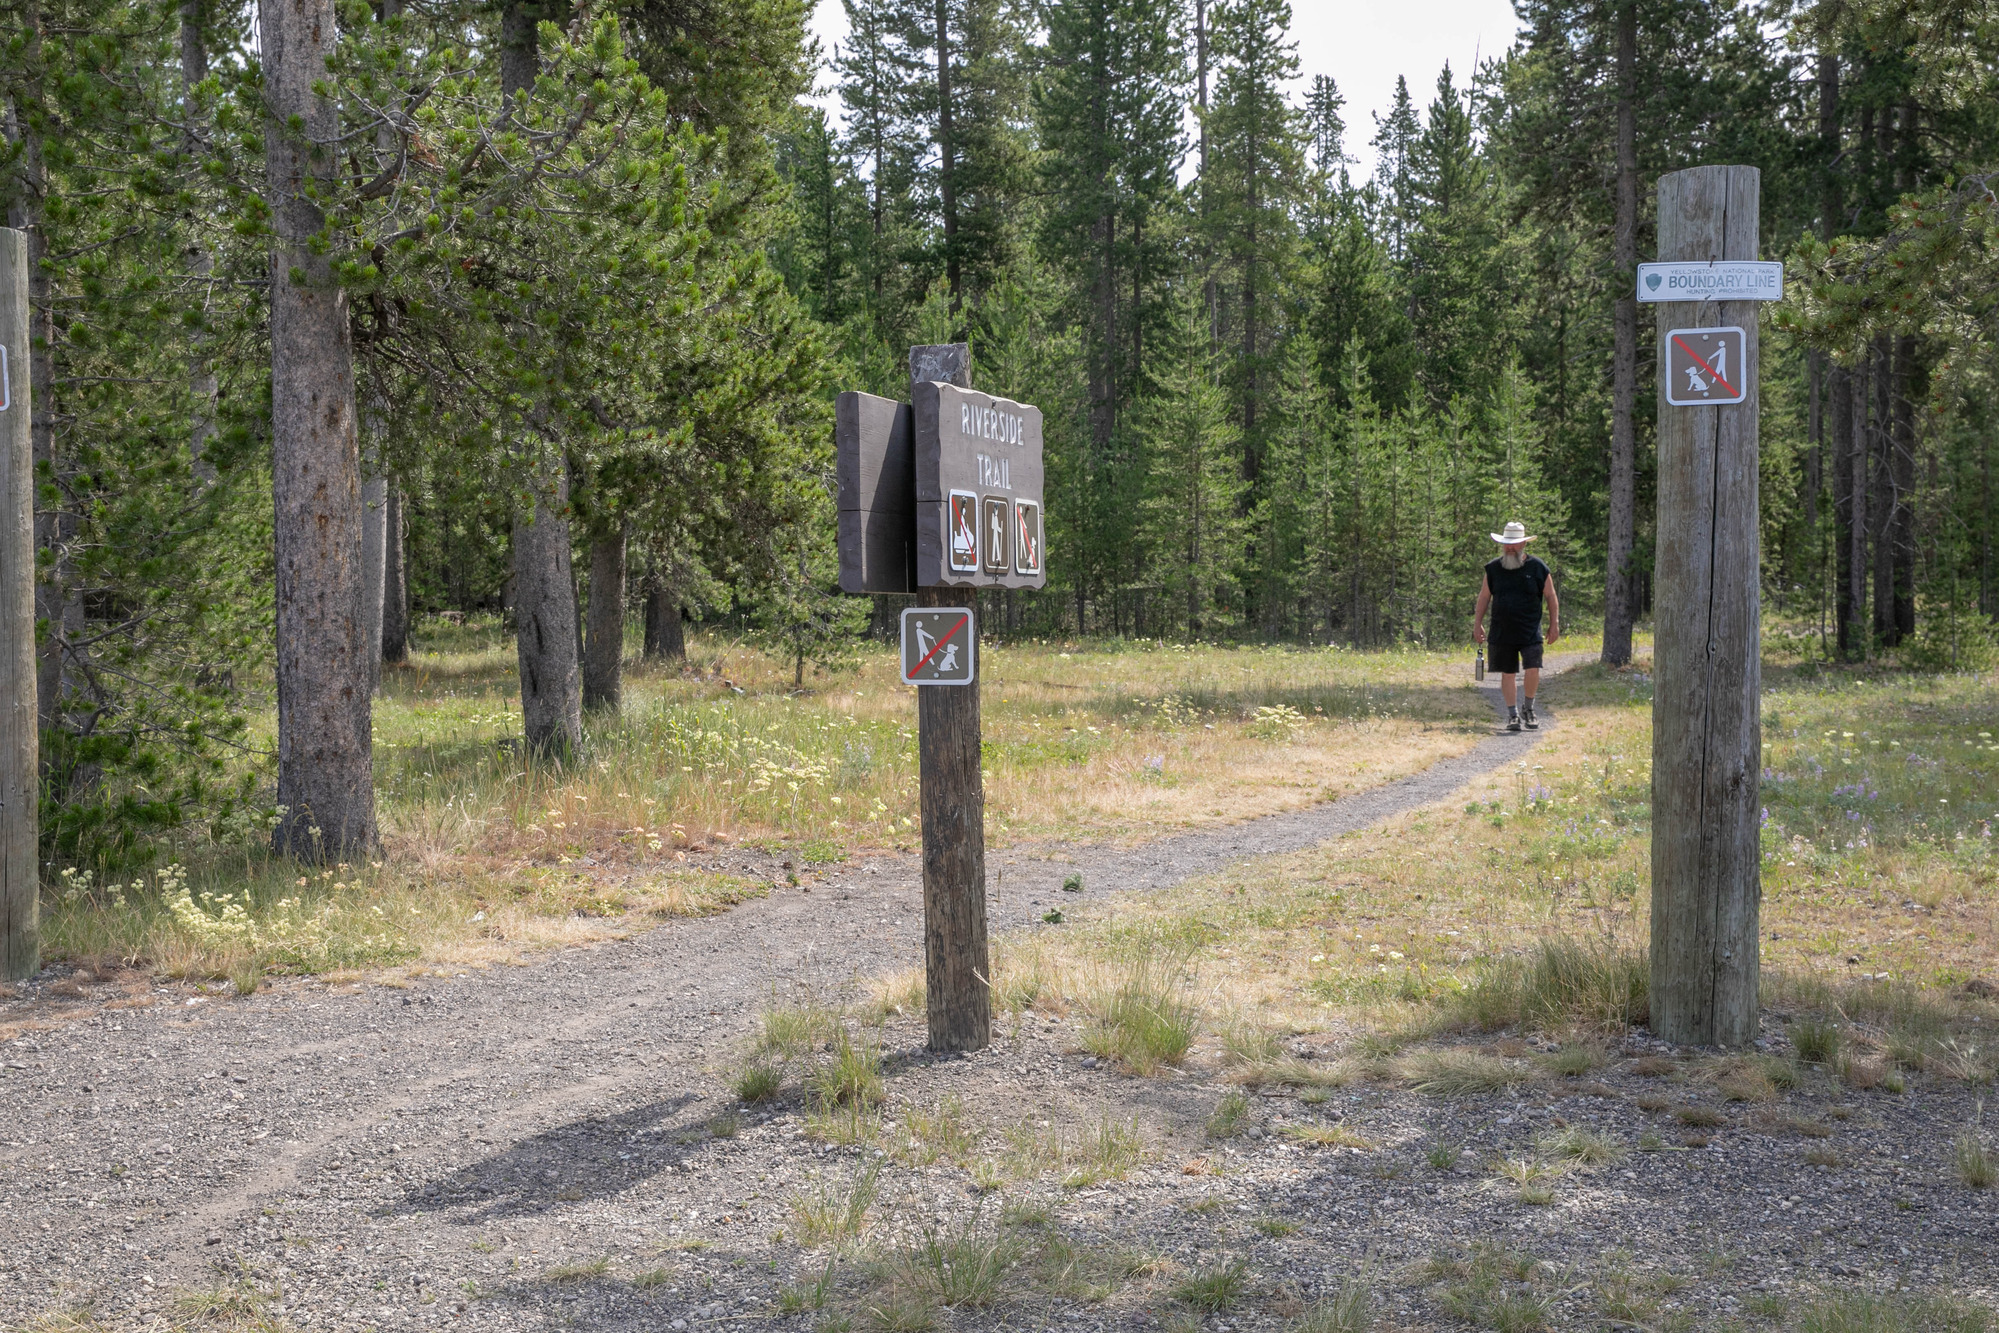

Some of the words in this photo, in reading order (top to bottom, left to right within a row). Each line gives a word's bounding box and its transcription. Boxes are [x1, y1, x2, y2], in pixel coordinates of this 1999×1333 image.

[1669, 275, 1742, 288] BOUNDARY
[1747, 275, 1776, 288] LINE
[961, 402, 1024, 446] RIVERSIDE
[976, 453, 1012, 490] TRAIL
